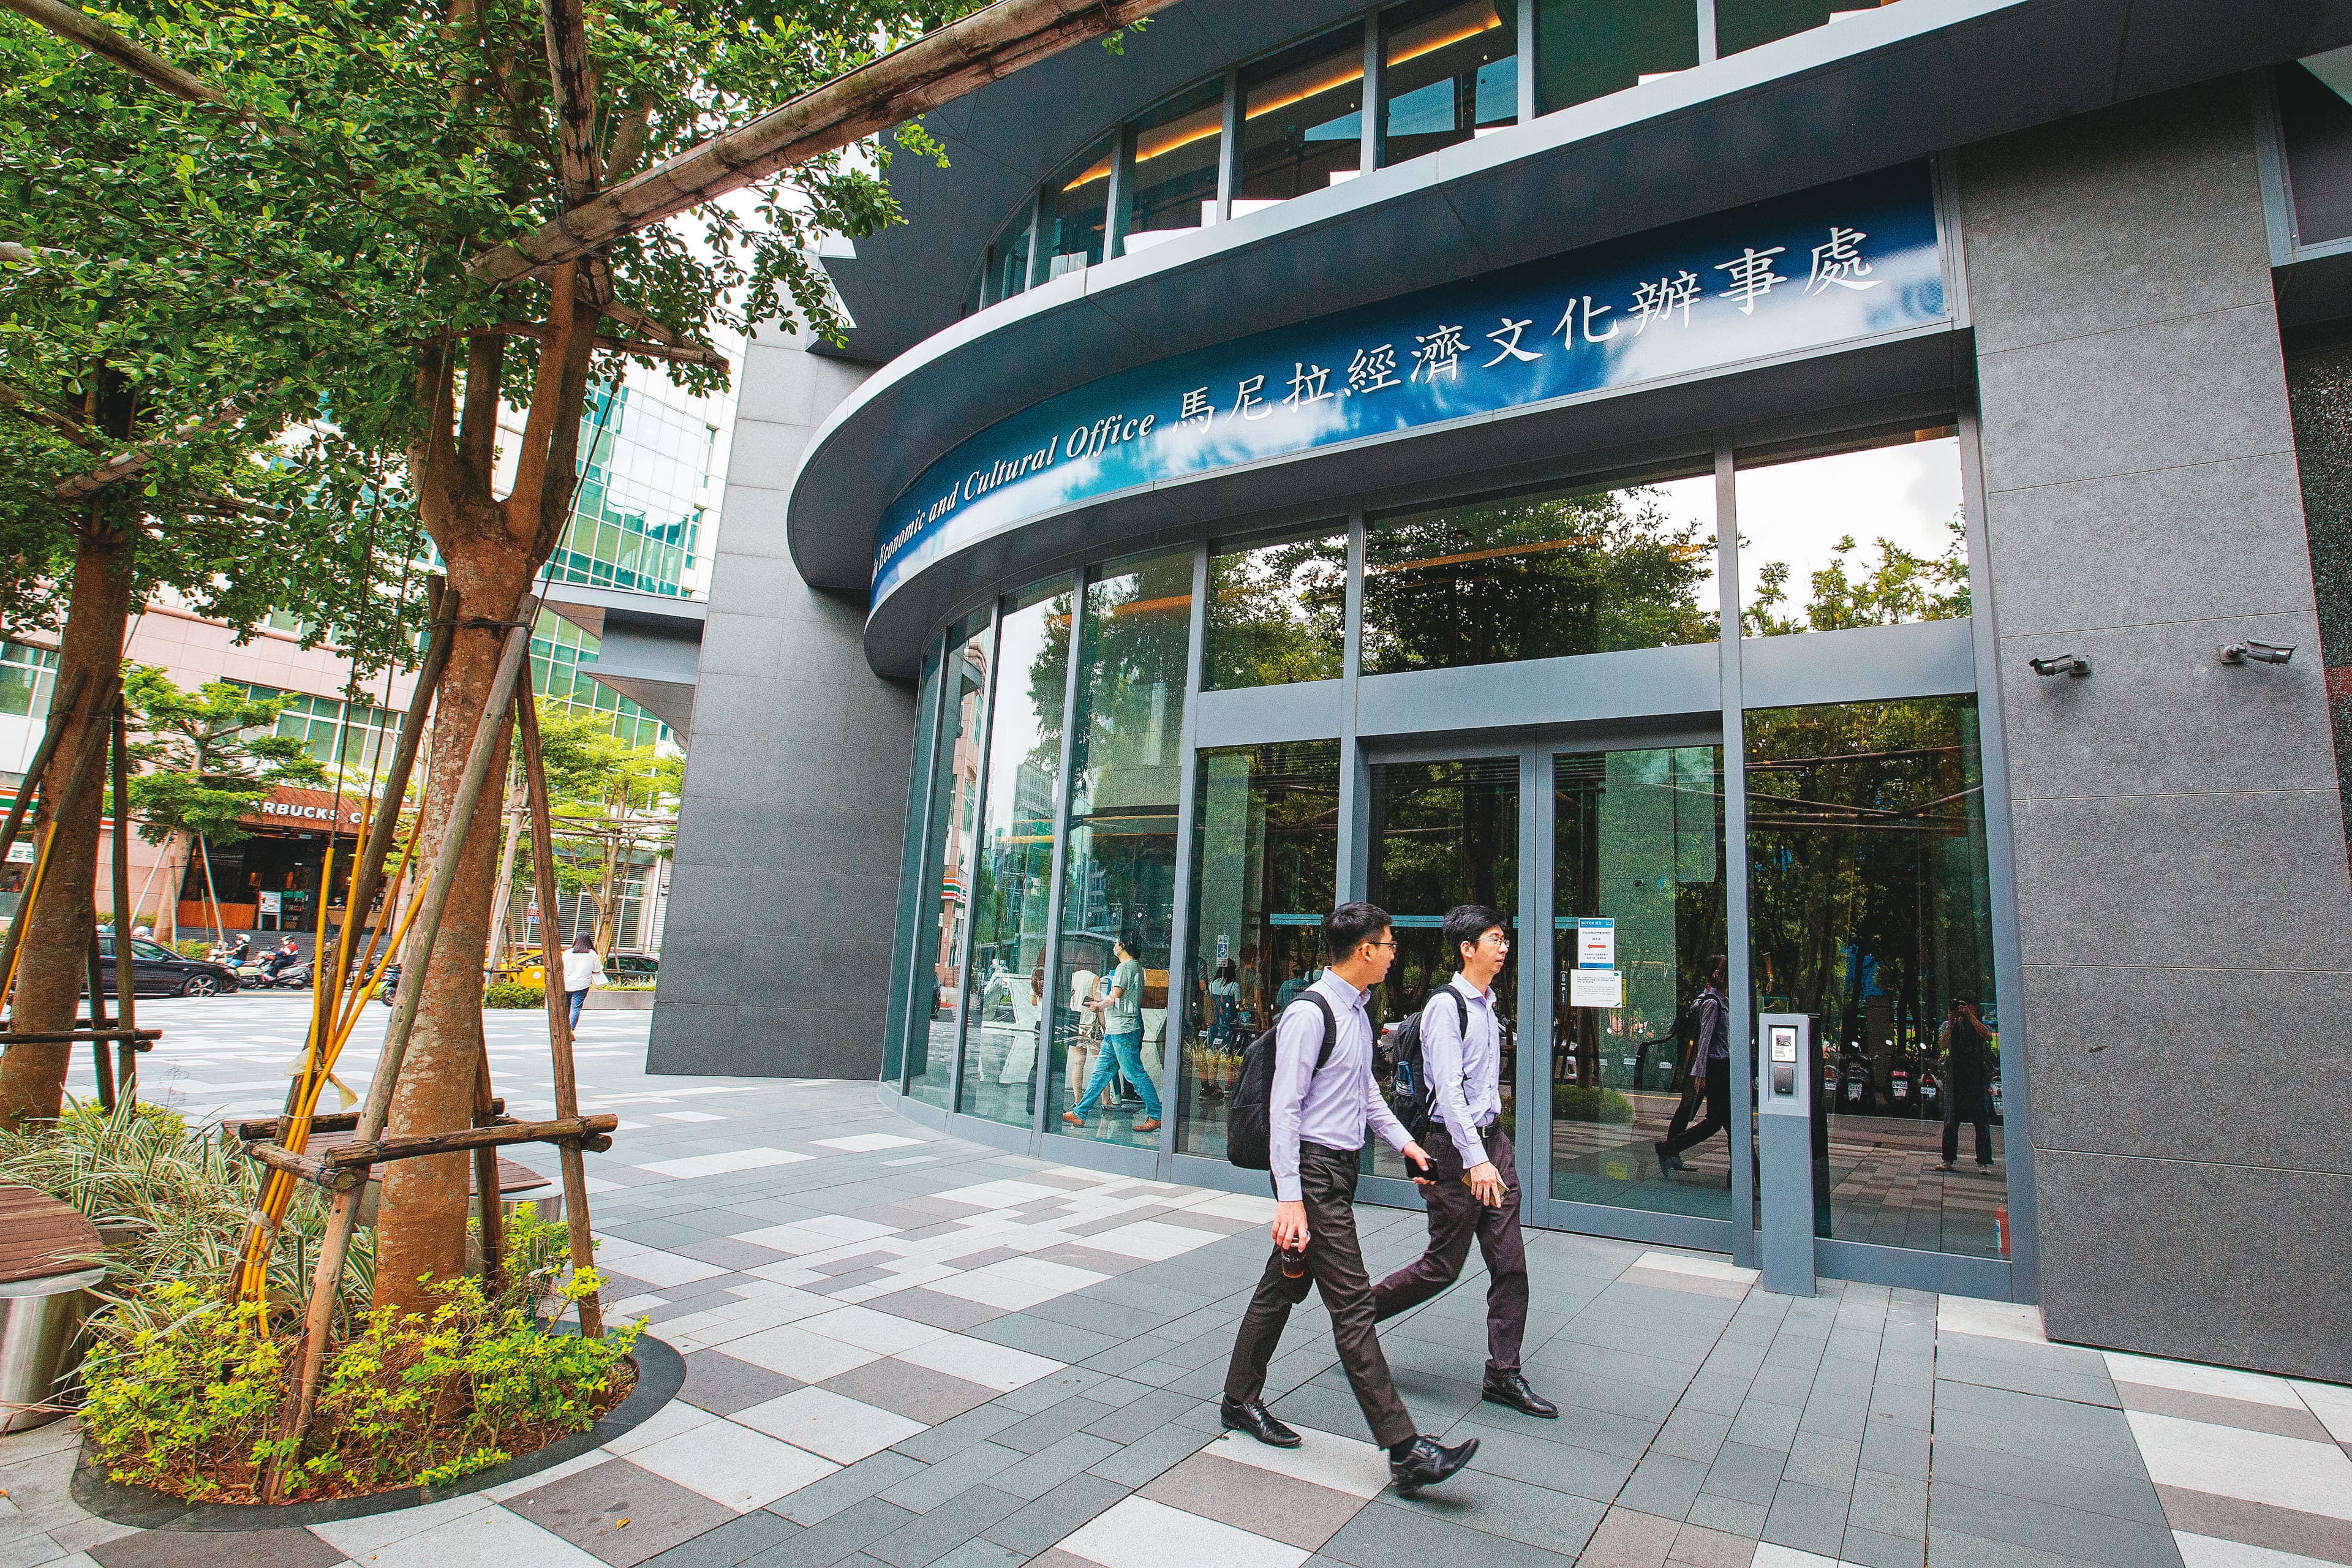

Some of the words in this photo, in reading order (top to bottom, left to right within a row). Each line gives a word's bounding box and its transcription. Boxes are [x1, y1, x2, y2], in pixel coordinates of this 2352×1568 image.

[1172, 227, 1883, 435] 馬尼拉經濟文化辦事處
[878, 509, 925, 571] Economic
[929, 481, 960, 523] and
[963, 435, 1058, 501] Cultural
[1066, 414, 1155, 460] Office
